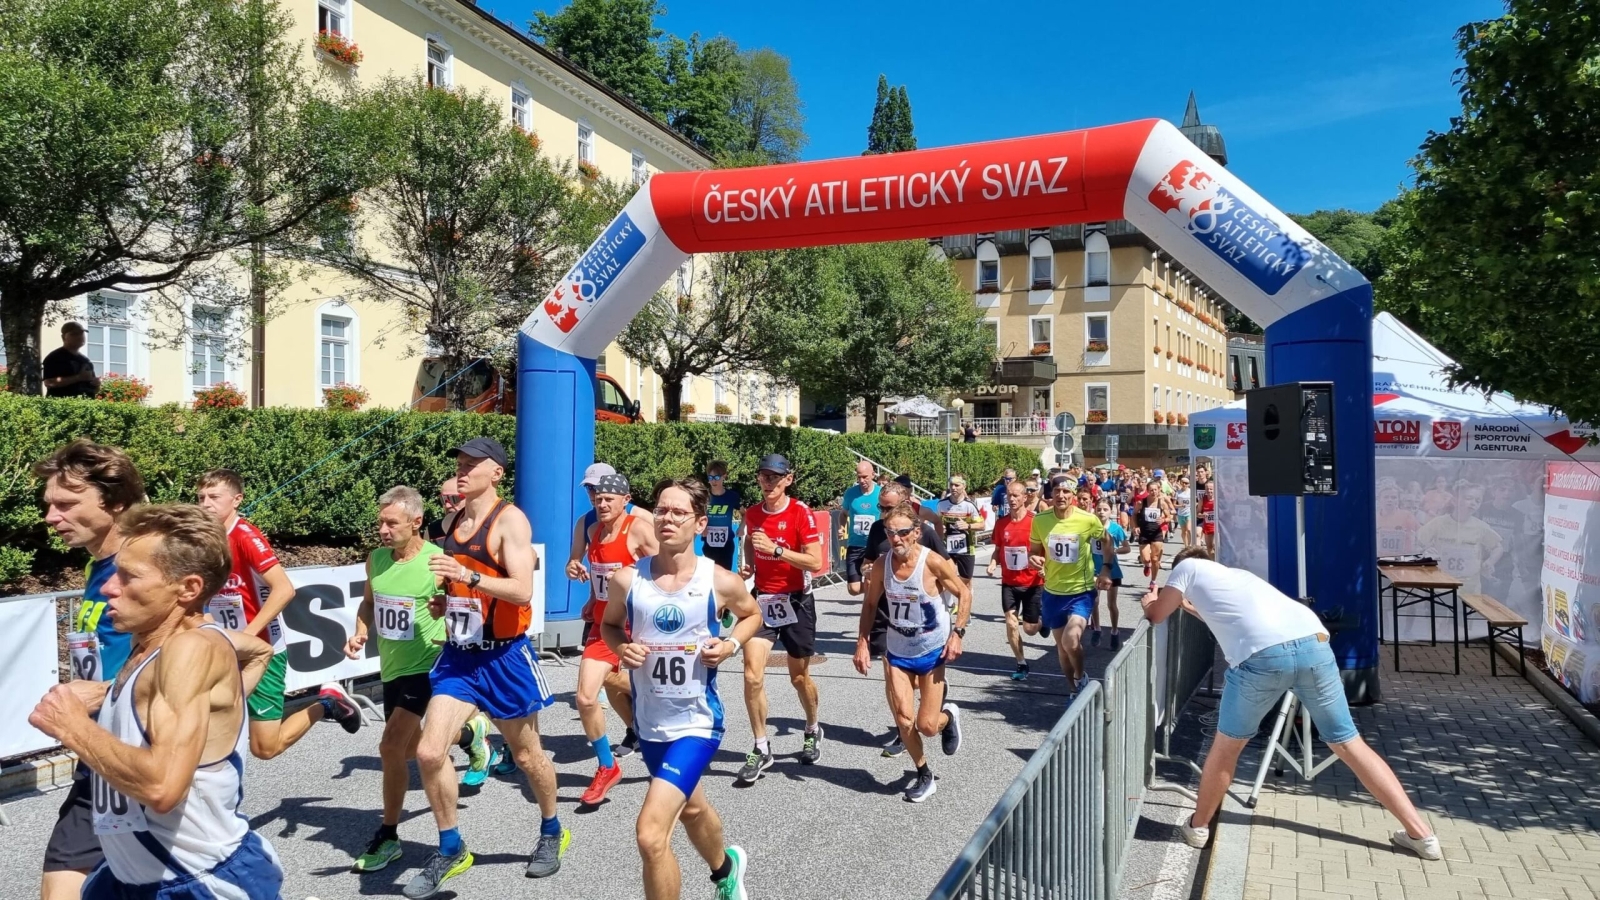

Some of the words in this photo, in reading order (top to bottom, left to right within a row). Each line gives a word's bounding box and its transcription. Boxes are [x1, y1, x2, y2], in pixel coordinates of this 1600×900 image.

[704, 178, 797, 224] ČESKÝ
[804, 160, 972, 216] ATLETICKÝ
[982, 156, 1069, 200] SVAZ
[1234, 207, 1278, 242] ČESKÝ
[582, 235, 608, 268] ČESKÝ
[588, 222, 633, 278] ATLETICKÝ
[1209, 232, 1246, 264] SVAZ
[1220, 220, 1295, 276] ATLETICKÝ
[596, 258, 620, 286] SVAZ
[1474, 423, 1520, 432] NÁRODNÍ
[1474, 434, 1530, 442] SPORTOVNÍ
[1474, 444, 1527, 452] AGENTURA
[860, 521, 870, 531] 12
[710, 532, 726, 543] 133
[950, 540, 965, 550] 105
[1055, 542, 1070, 557] 91
[1012, 554, 1018, 566] 7
[220, 609, 238, 630] 15
[378, 607, 410, 632] 108
[768, 603, 787, 620] 43
[892, 602, 910, 620] 77
[652, 656, 686, 686] 46
